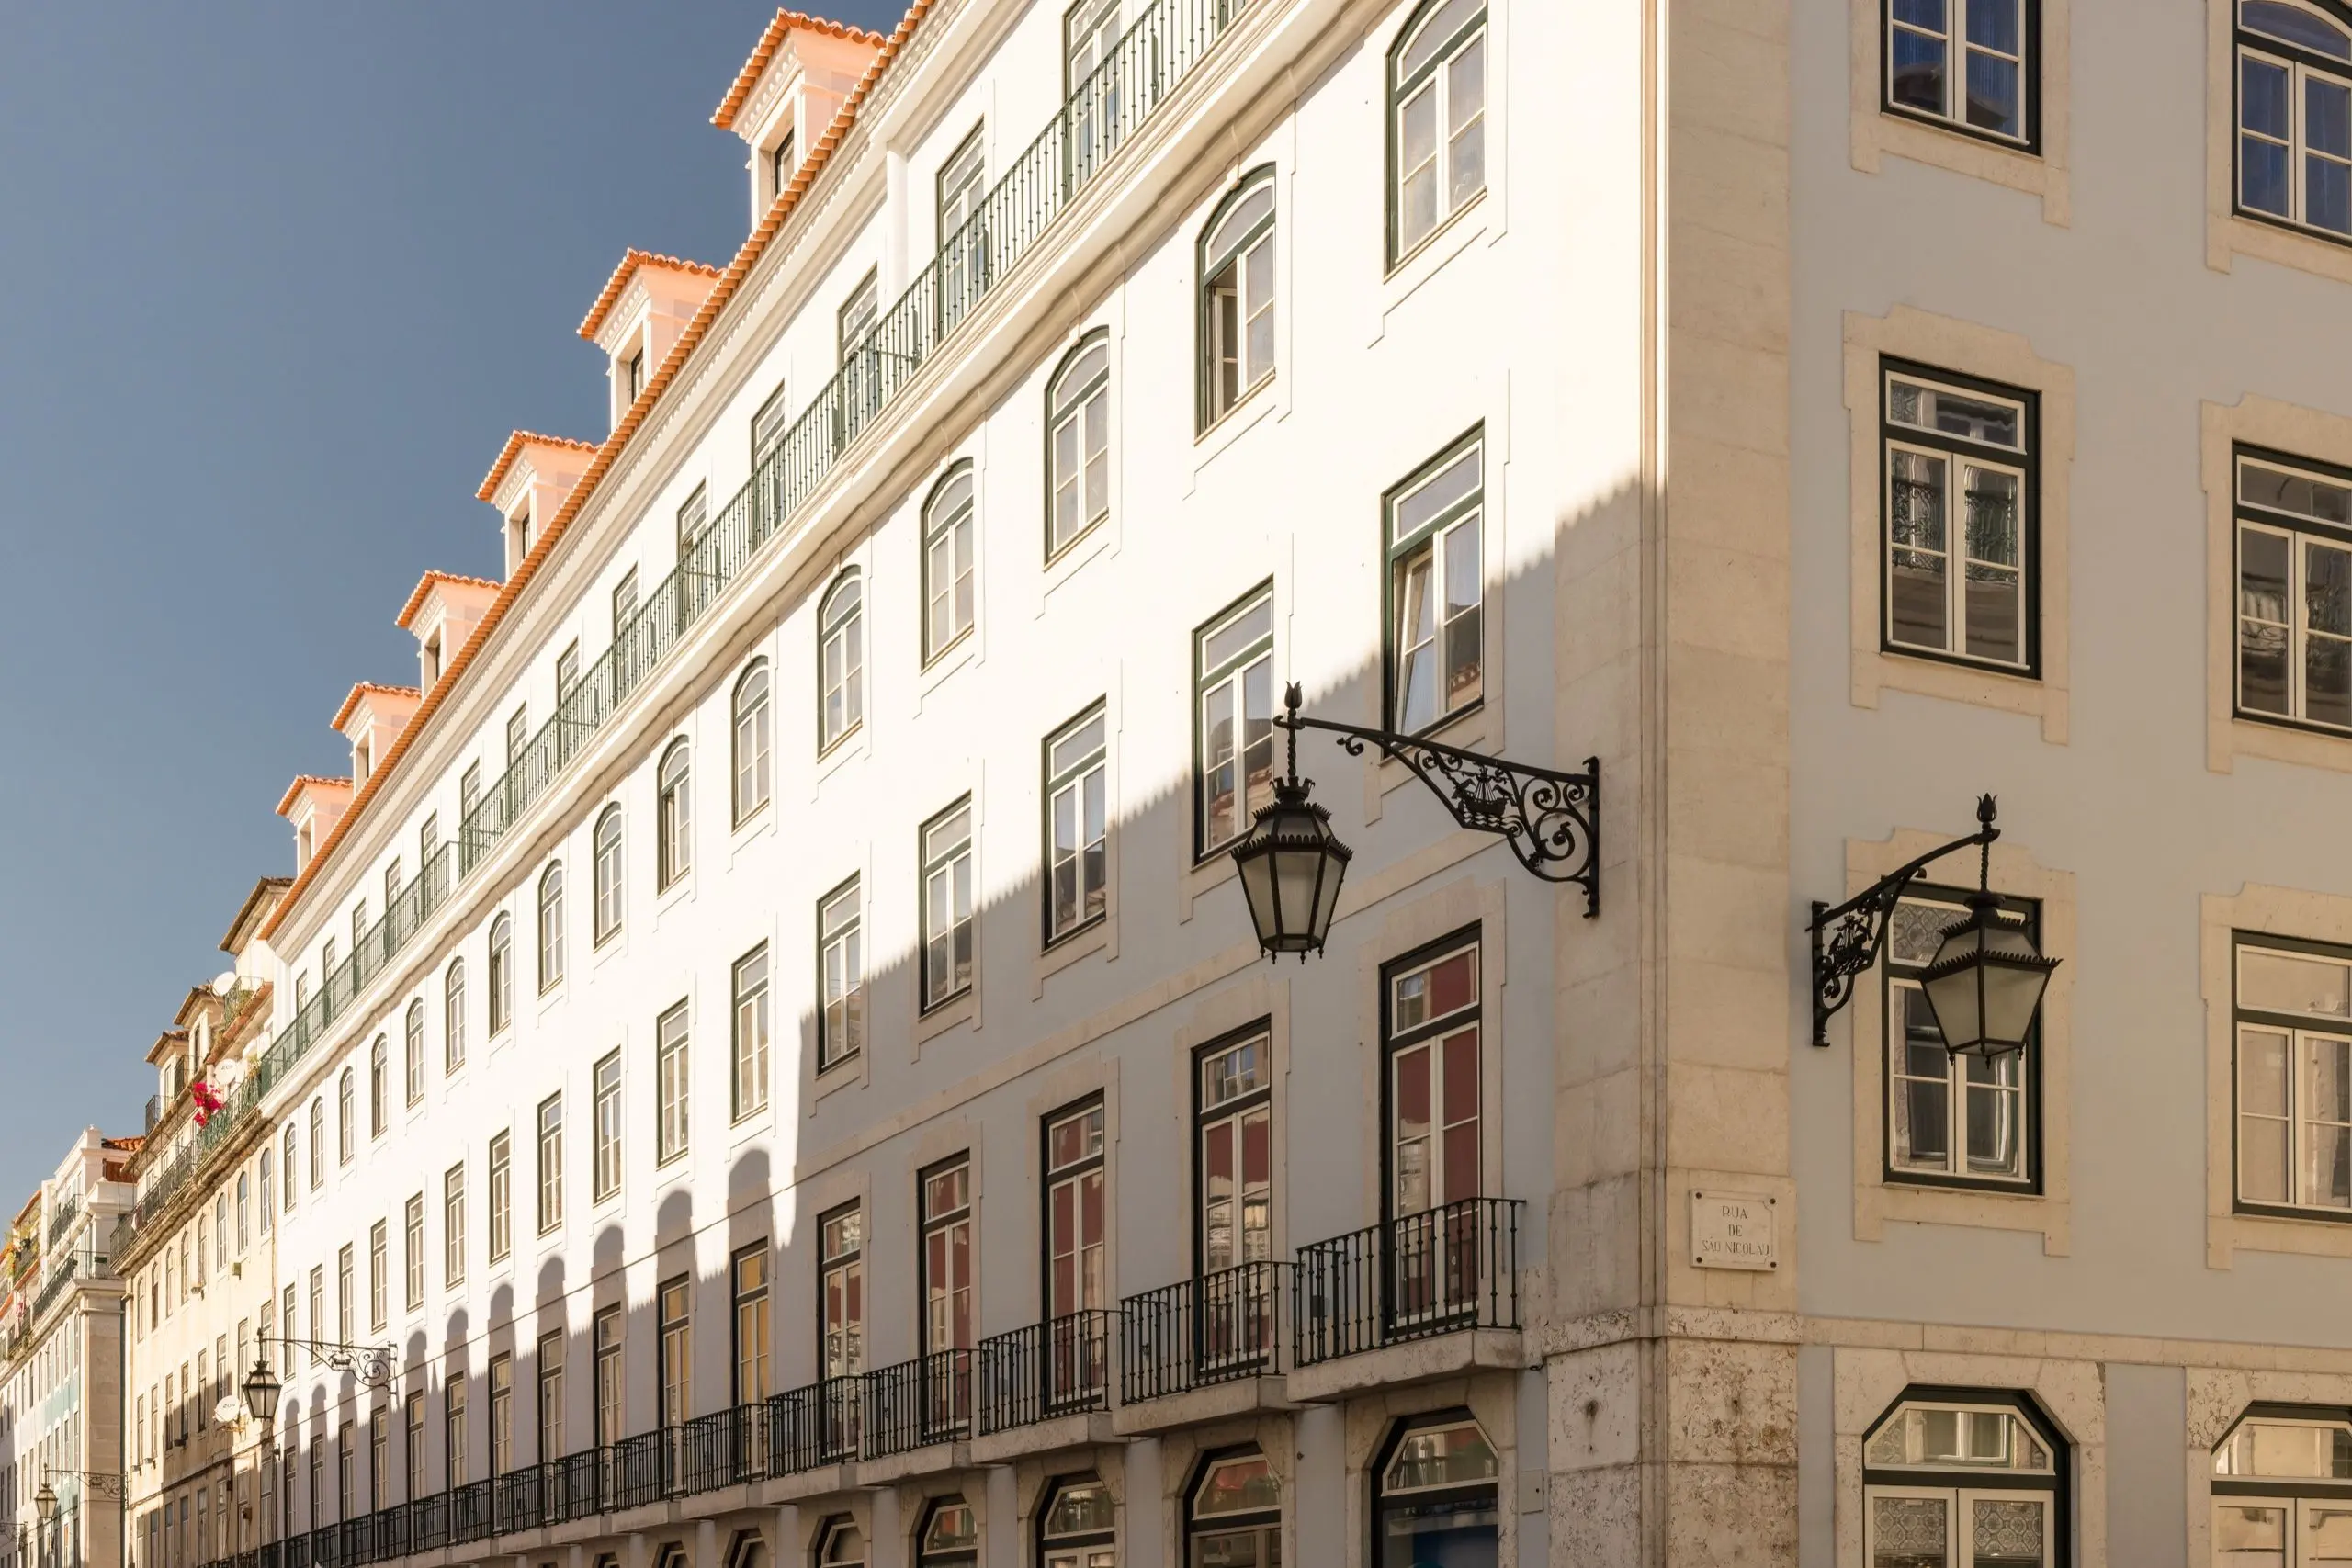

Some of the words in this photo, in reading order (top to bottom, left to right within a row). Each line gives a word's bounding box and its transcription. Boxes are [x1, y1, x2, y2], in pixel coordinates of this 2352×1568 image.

[1721, 1205, 1747, 1219] RUA
[1728, 1224, 1743, 1237] DE
[1702, 1235, 1721, 1252] SÃO
[1725, 1241, 1770, 1257] NICOLAU
